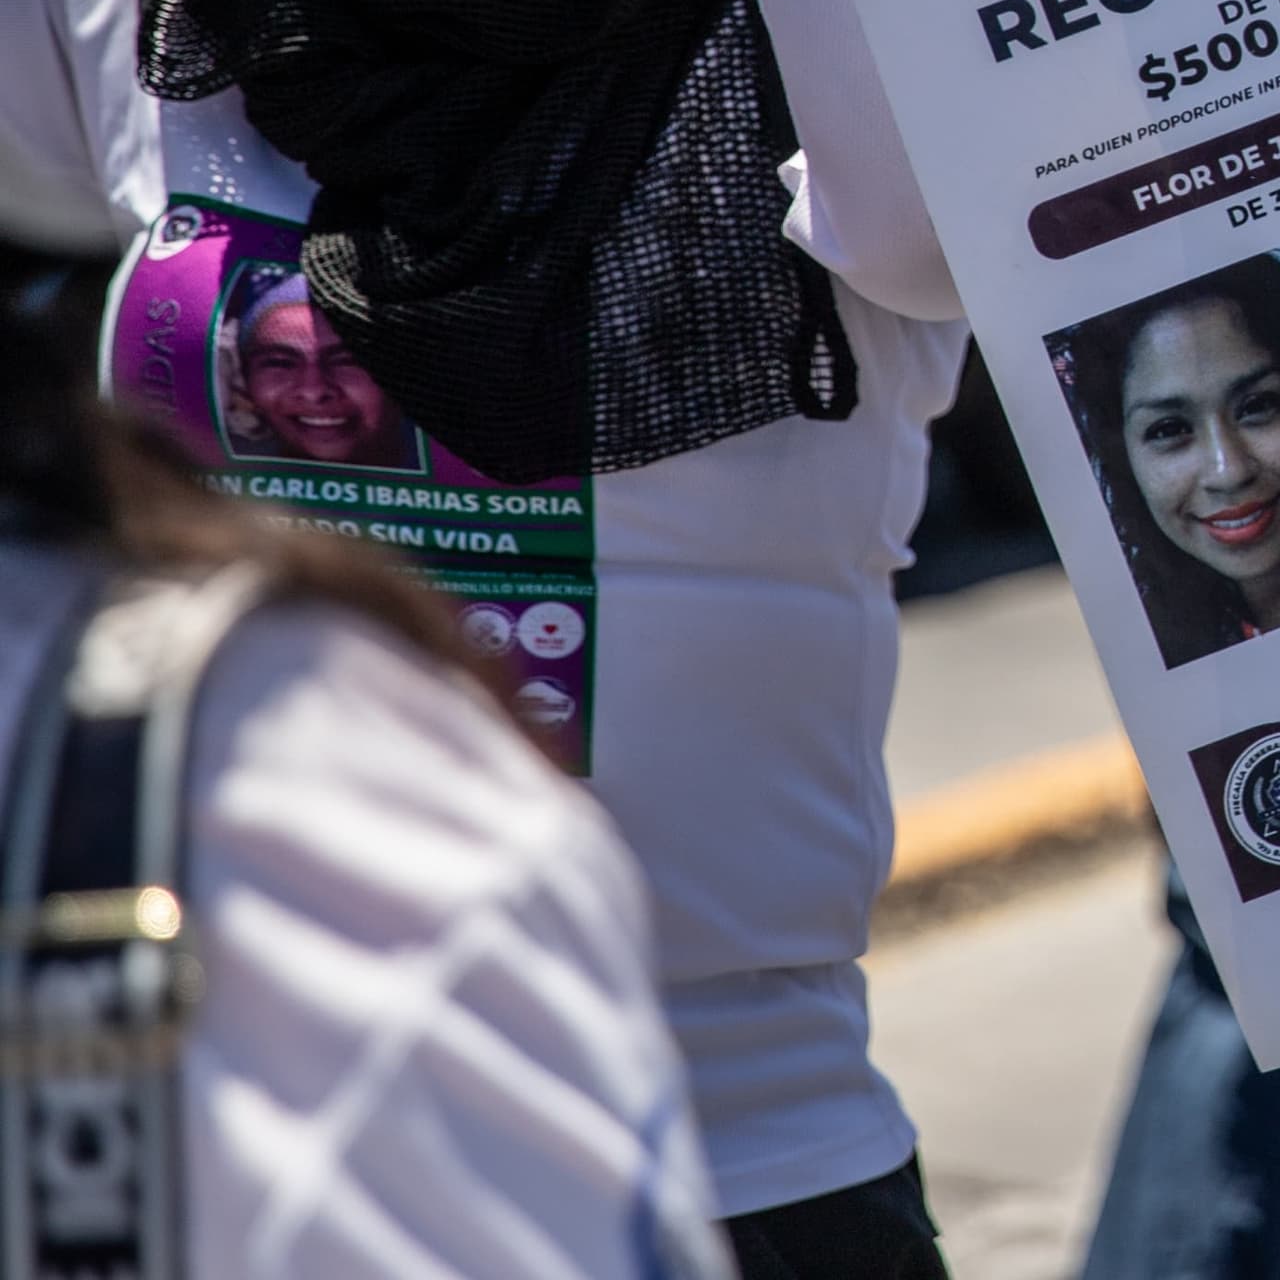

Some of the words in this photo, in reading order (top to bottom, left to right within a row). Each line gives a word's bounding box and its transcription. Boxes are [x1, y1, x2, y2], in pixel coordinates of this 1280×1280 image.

[1034, 153, 1079, 179] PARA
[1081, 131, 1133, 161] QUIEN
[1136, 85, 1254, 140] PROPORCIONE
[1131, 164, 1215, 211] FLOR
[1217, 144, 1265, 179] DE
[1225, 195, 1268, 228] DE
[249, 476, 359, 503] CARLOS
[367, 485, 480, 513] IBARIAS
[487, 495, 583, 516] SORIA
[368, 523, 425, 547] SIN
[433, 528, 520, 554] VIDA
[1230, 769, 1247, 816] FISCALÍA
